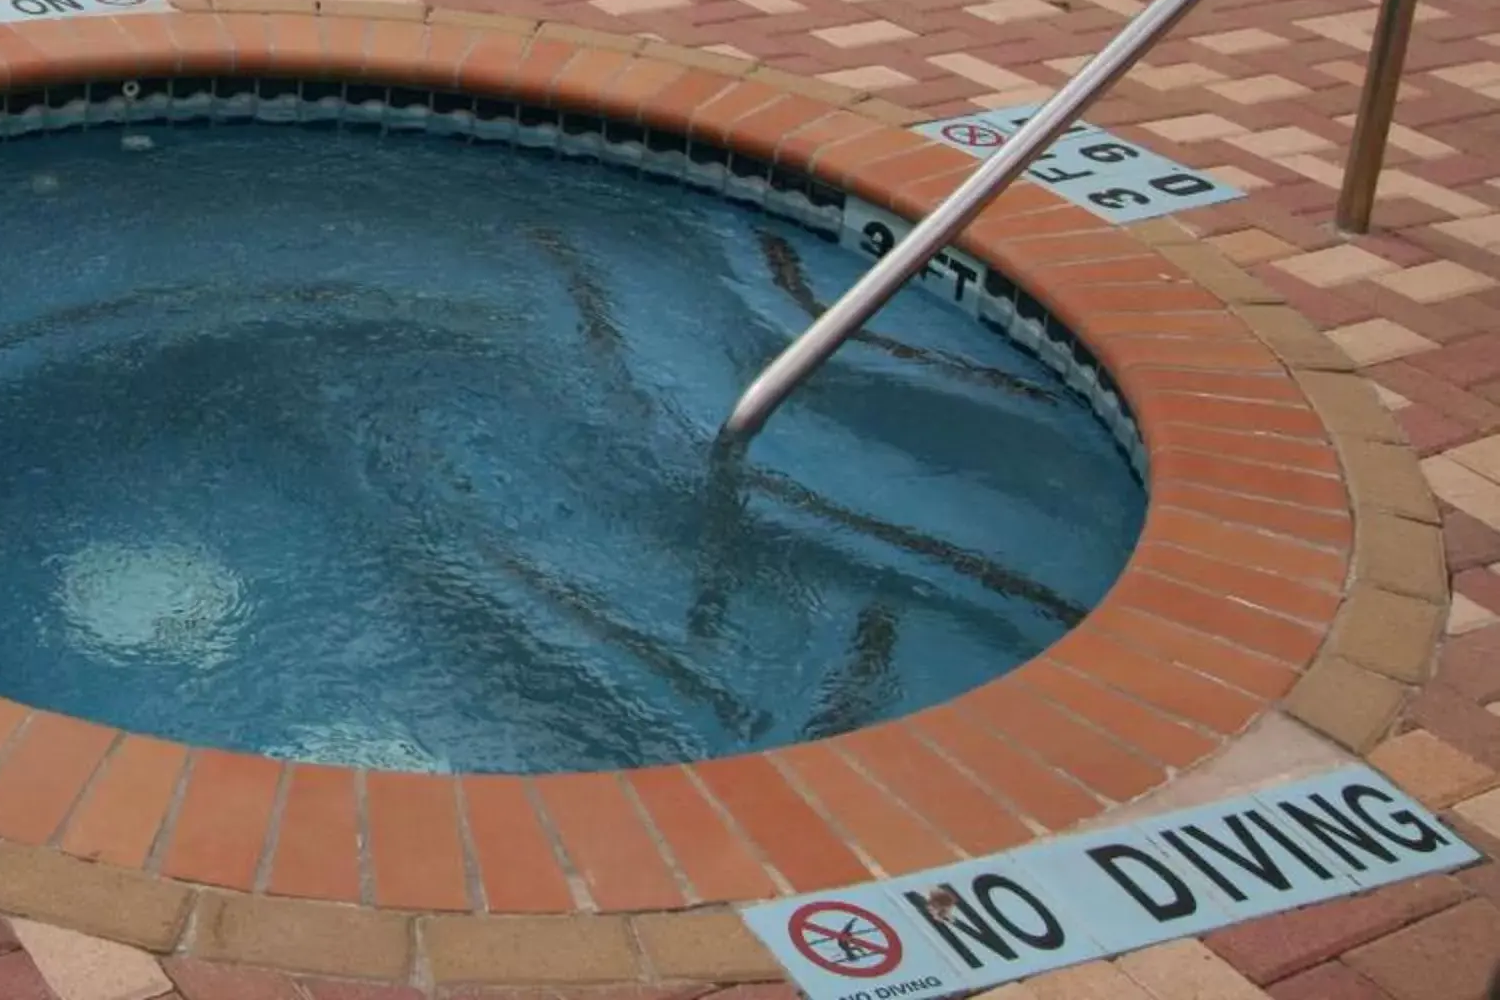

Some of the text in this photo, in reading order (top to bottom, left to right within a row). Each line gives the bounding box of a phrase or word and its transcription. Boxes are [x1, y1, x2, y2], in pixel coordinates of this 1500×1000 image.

[1087, 187, 1150, 209] 3
[905, 782, 1449, 970] NO DIVING
[874, 975, 943, 1000] DIVING
